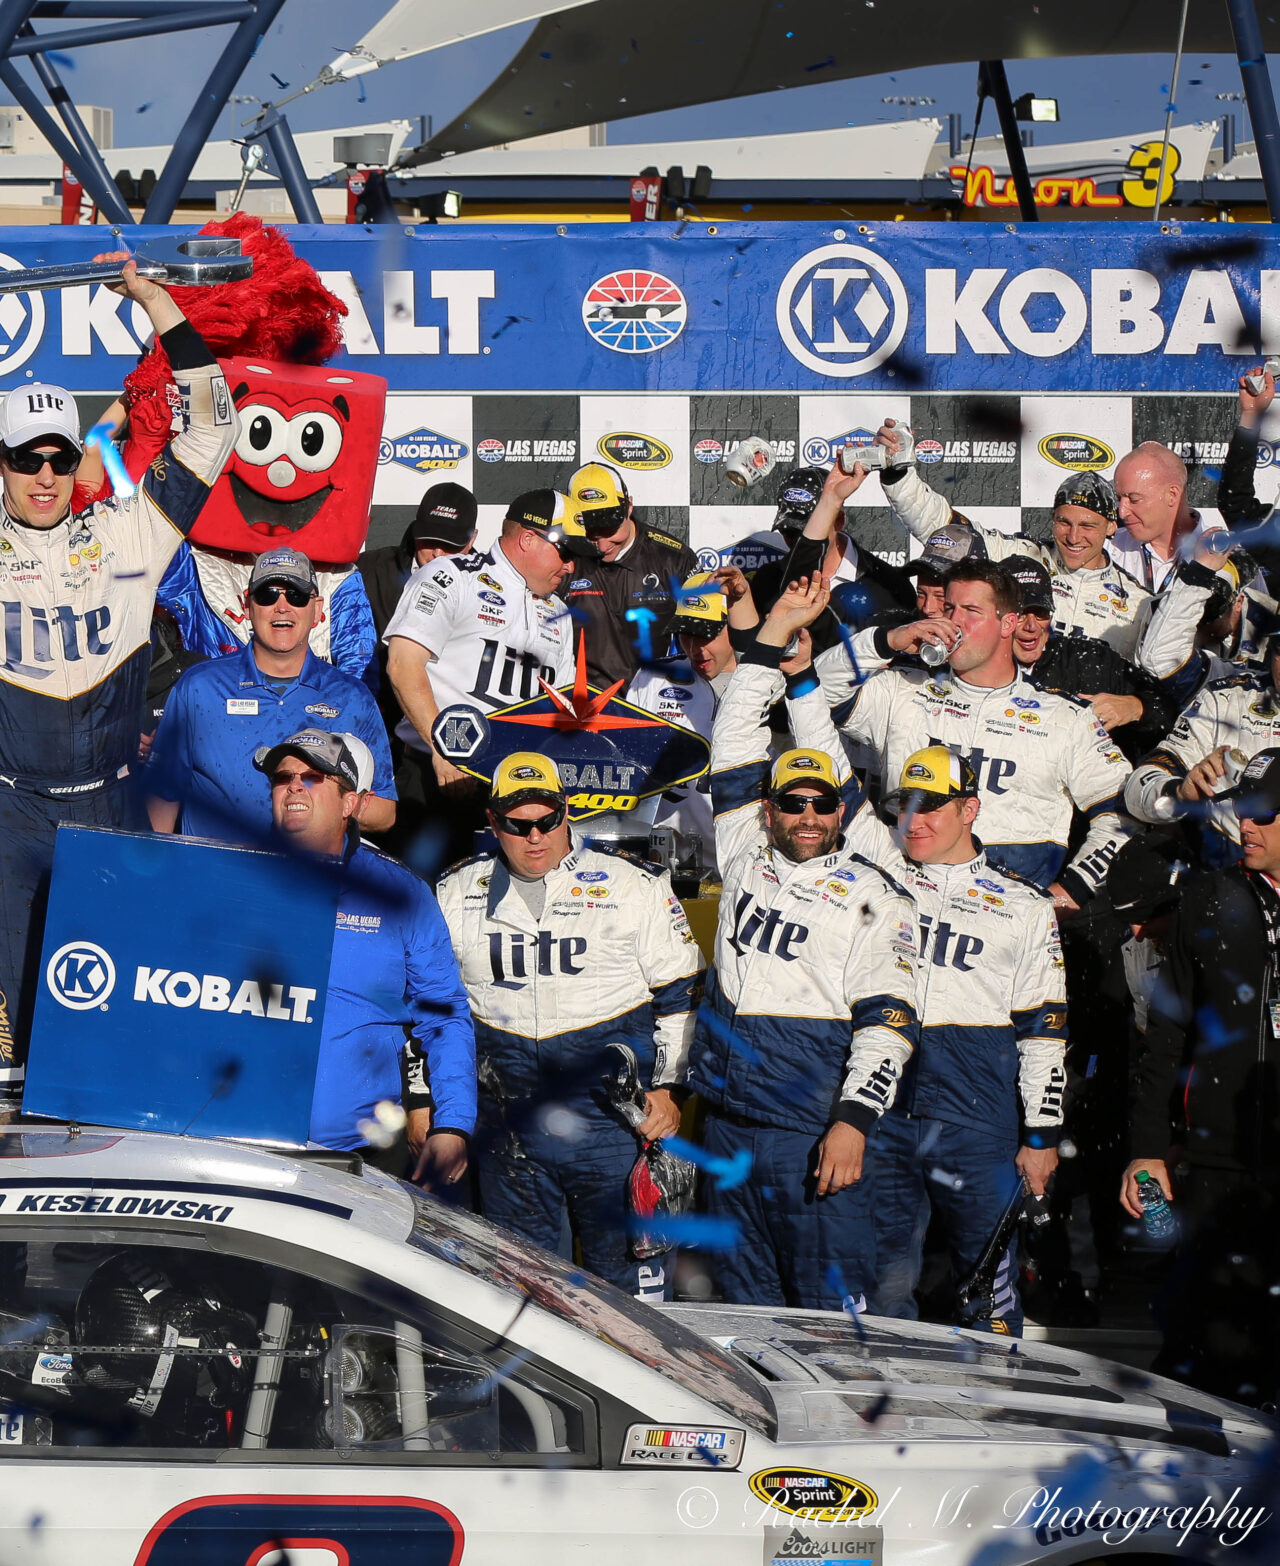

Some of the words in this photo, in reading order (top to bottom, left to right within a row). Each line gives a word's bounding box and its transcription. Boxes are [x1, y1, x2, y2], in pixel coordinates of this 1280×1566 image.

[1121, 139, 1182, 208] 3
[26, 392, 64, 413] Lite
[396, 444, 461, 458] KOBALT
[506, 440, 531, 456] LAS
[532, 440, 576, 456] VEGAS
[617, 439, 644, 448] NASCAR
[944, 442, 970, 456] LAS
[971, 442, 1017, 457] VEGAS
[1058, 441, 1086, 449] NASCAR
[1193, 442, 1230, 457] VEGA
[532, 455, 575, 463] SPEEDWAY
[622, 447, 648, 459] Sprint
[1063, 449, 1091, 461] Sprint
[416, 460, 459, 469] 400
[429, 511, 459, 520] PENSKE
[436, 505, 456, 513] TEAM
[10, 561, 41, 572] SKF
[483, 591, 506, 606] Ford
[481, 604, 504, 616] SKF
[659, 701, 686, 711] SKF
[945, 698, 971, 711] SKF
[558, 764, 636, 791] BALT
[48, 779, 105, 795] ESELOWSKI
[567, 793, 639, 811] 400
[1075, 838, 1120, 886] Lite
[581, 872, 603, 882] Ford
[360, 915, 381, 925] VEGAS
[726, 888, 809, 963] Lite
[919, 912, 985, 972] ite
[484, 930, 587, 992] Lite
[133, 966, 317, 1023] KOBALT
[855, 1057, 898, 1107] Lite
[1038, 1066, 1066, 1119] Lite
[16, 1194, 235, 1223] KESELOWSKI
[668, 1430, 724, 1449] NASCAR
[629, 1449, 682, 1461] RACE
[783, 1477, 828, 1488] NASCAR
[793, 1488, 836, 1503] Sprint
[779, 1535, 829, 1557] Coors
[831, 1540, 877, 1555] LIGHT
